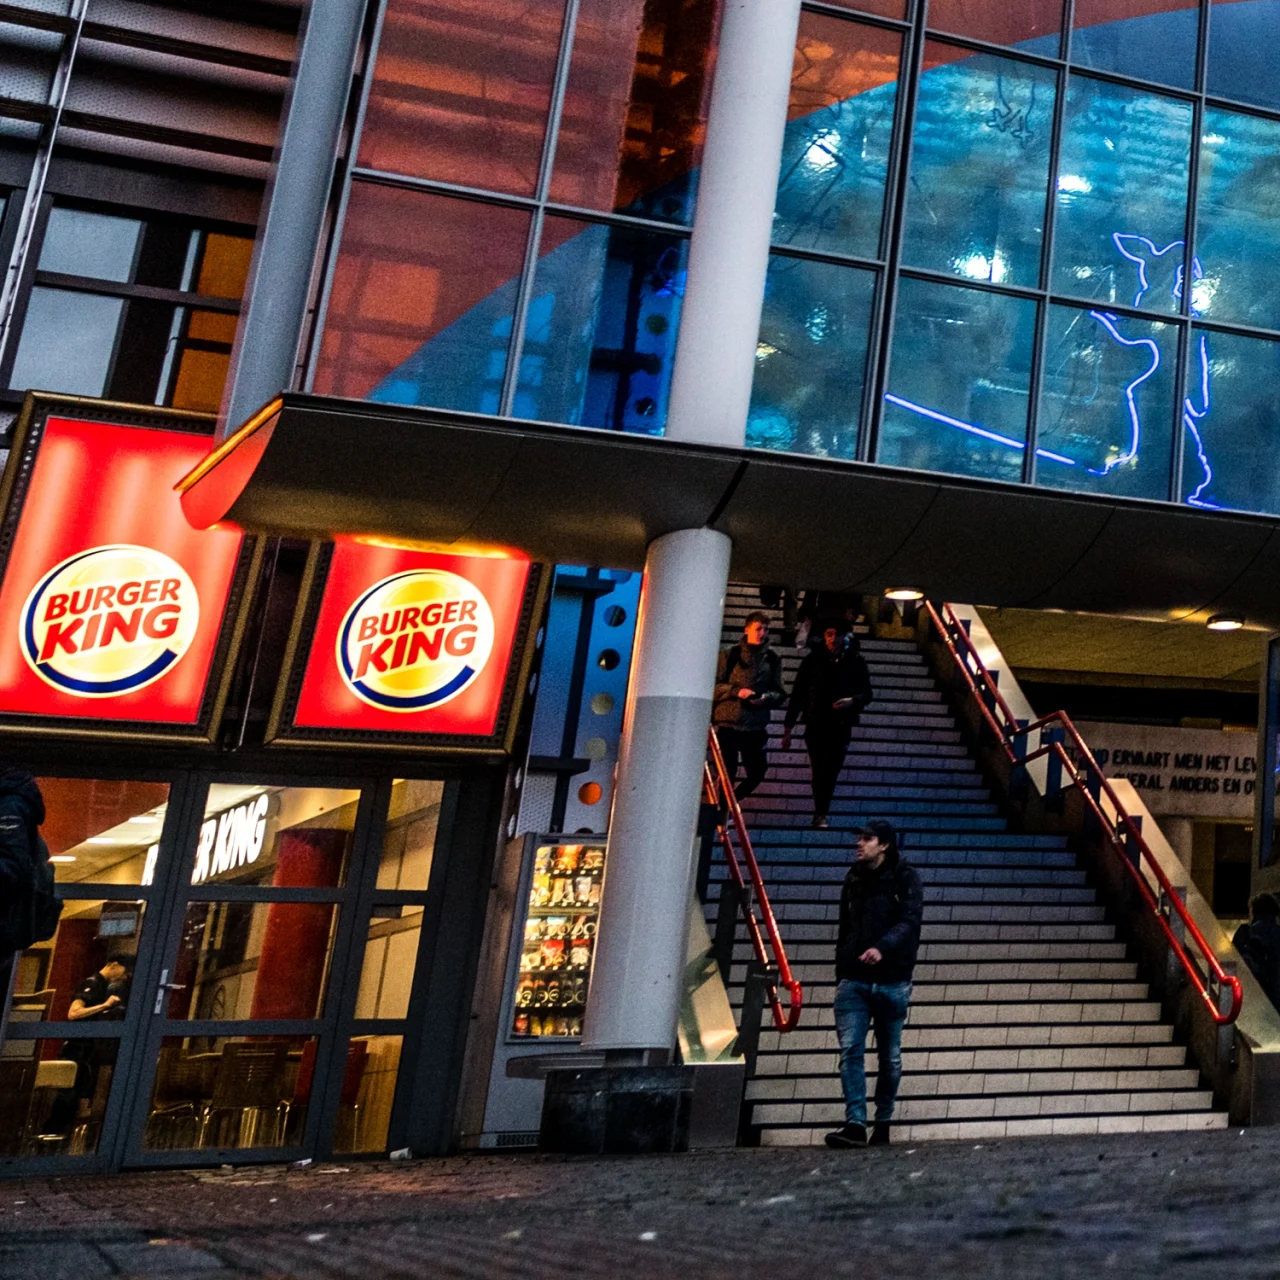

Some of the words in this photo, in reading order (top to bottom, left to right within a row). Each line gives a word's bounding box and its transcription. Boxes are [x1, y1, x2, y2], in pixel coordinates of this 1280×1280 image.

[43, 578, 182, 622] BURGER
[357, 600, 478, 642] BURGER
[40, 604, 182, 661] KING
[355, 624, 478, 679] KING
[1113, 749, 1171, 768] ERVAART
[1174, 753, 1202, 769] MEN
[1206, 754, 1230, 772] HET
[1169, 775, 1219, 793] ANDERS
[1223, 778, 1240, 794] EN
[210, 793, 269, 877] KING
